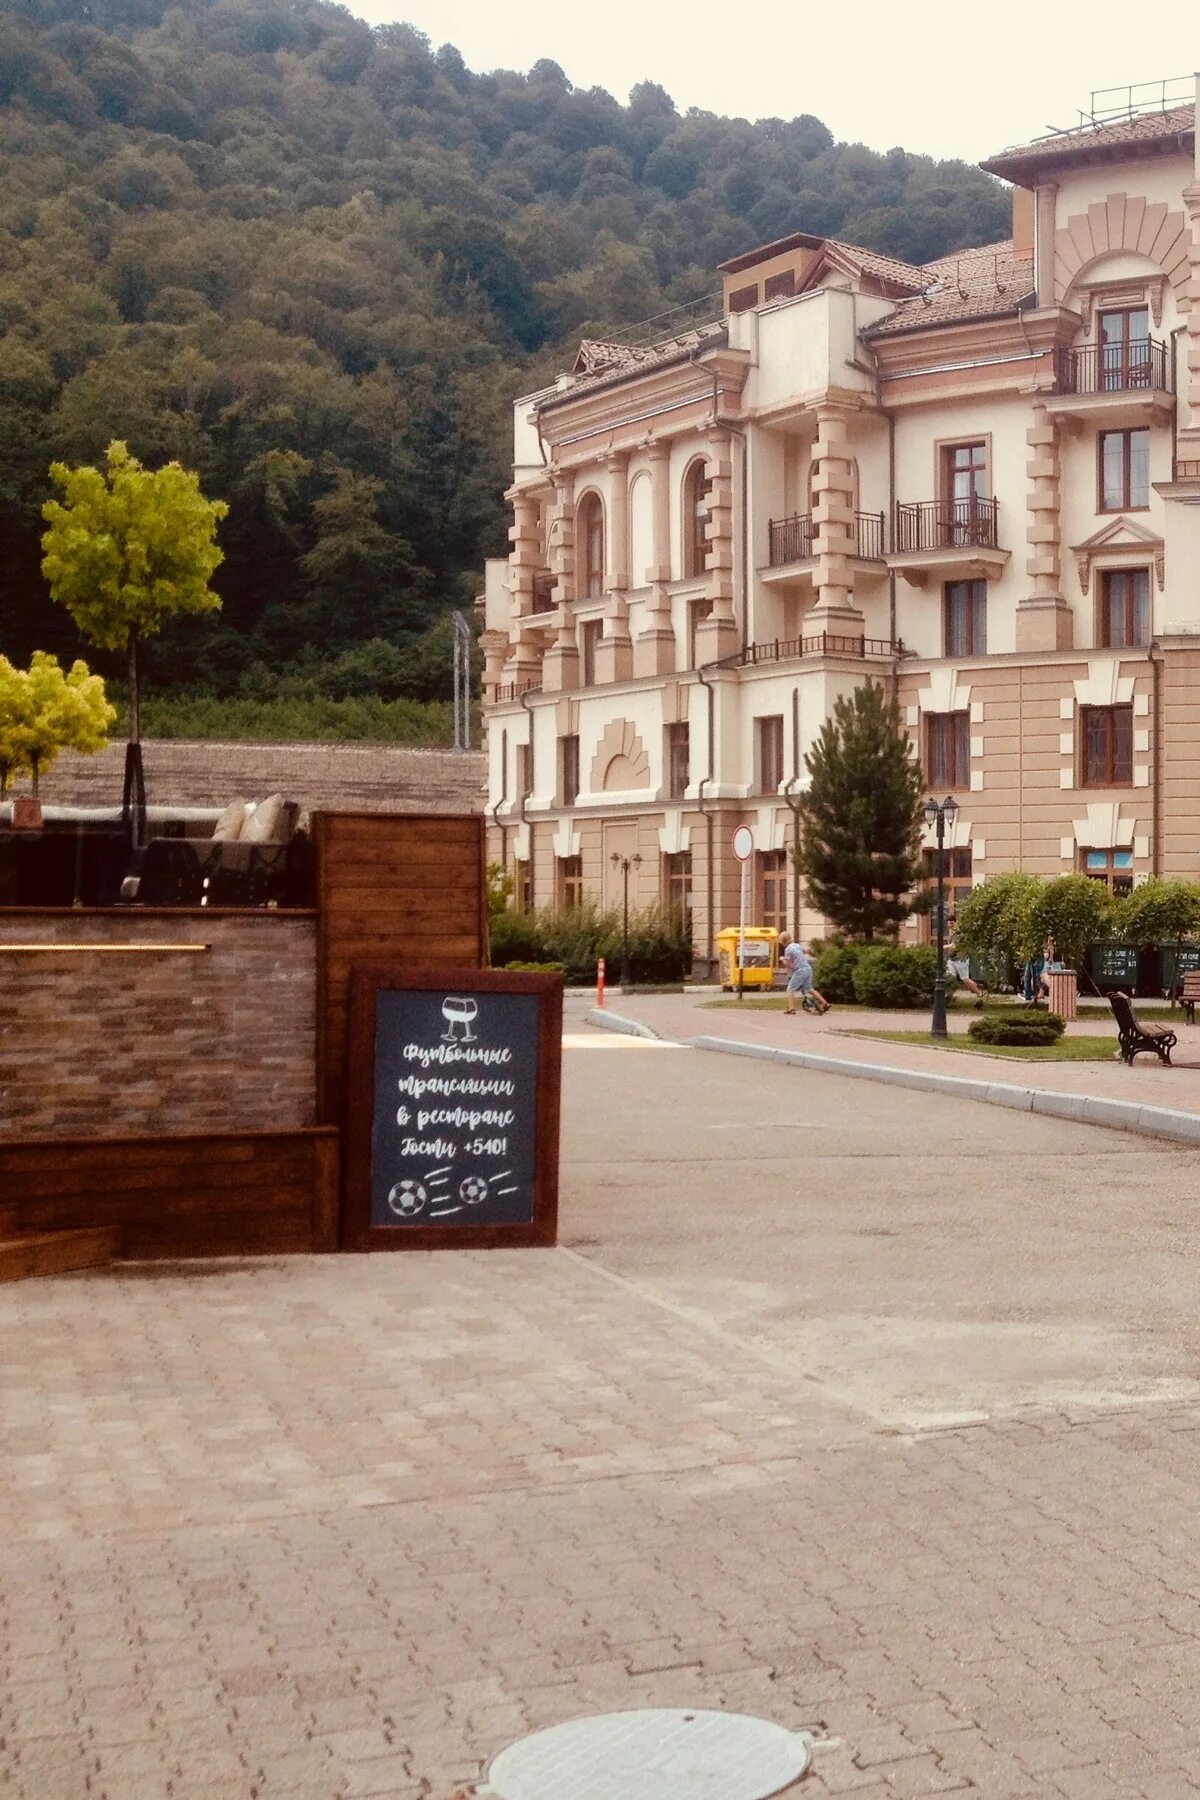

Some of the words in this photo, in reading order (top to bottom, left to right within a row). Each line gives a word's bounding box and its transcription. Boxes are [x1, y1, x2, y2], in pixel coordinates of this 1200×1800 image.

[403, 1043, 512, 1068] Футбольные
[398, 1075, 515, 1099] трансляции
[396, 1105, 411, 1126] в
[417, 1106, 515, 1131] ресторане
[401, 1138, 457, 1159] Гости
[463, 1138, 507, 1156] +540!
